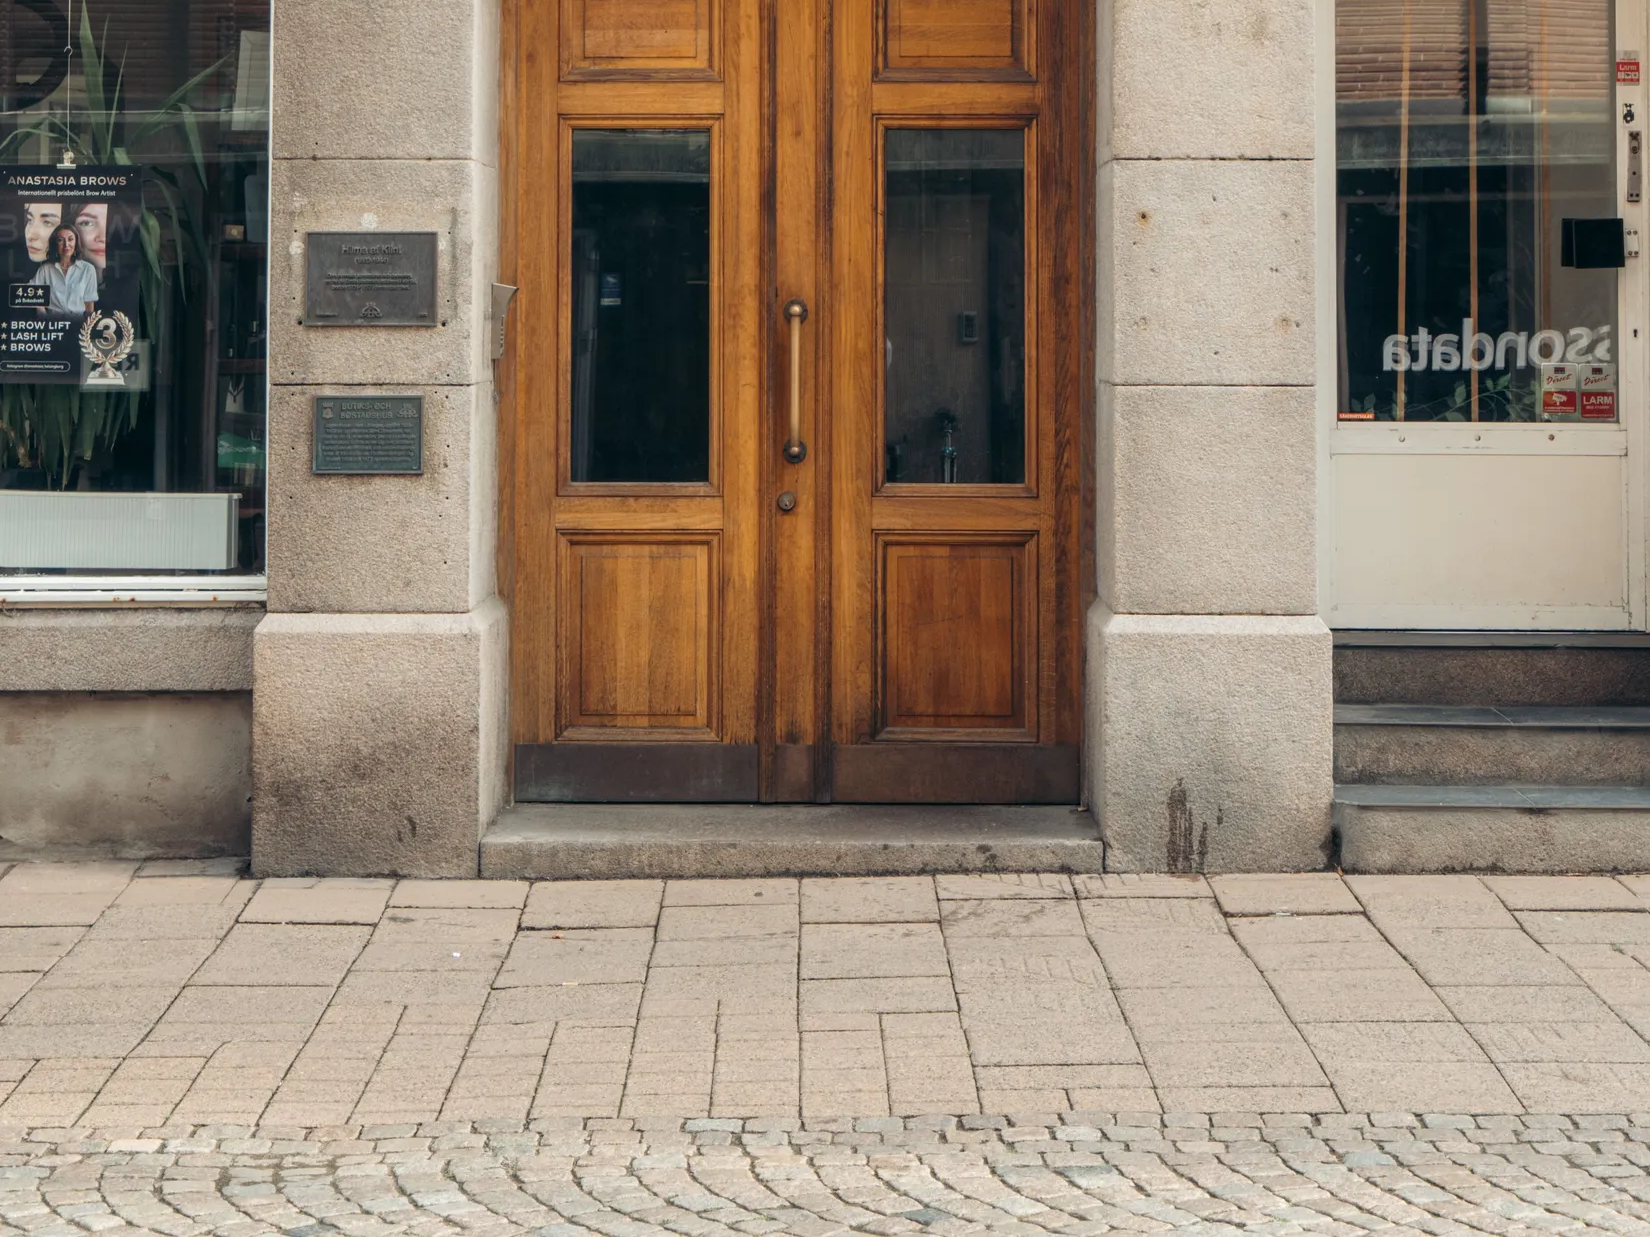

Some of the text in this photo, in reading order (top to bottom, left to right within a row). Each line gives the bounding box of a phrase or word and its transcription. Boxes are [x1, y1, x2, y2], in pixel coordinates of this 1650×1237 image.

[7, 176, 127, 186] ANASTASIA BROWS
[16, 287, 35, 297] 4.9
[10, 320, 71, 330] BROW LIFT
[10, 332, 64, 341] LASH LIFT
[95, 317, 117, 350] 3
[10, 343, 51, 352] BROWS
[1582, 395, 1613, 405] LARM
